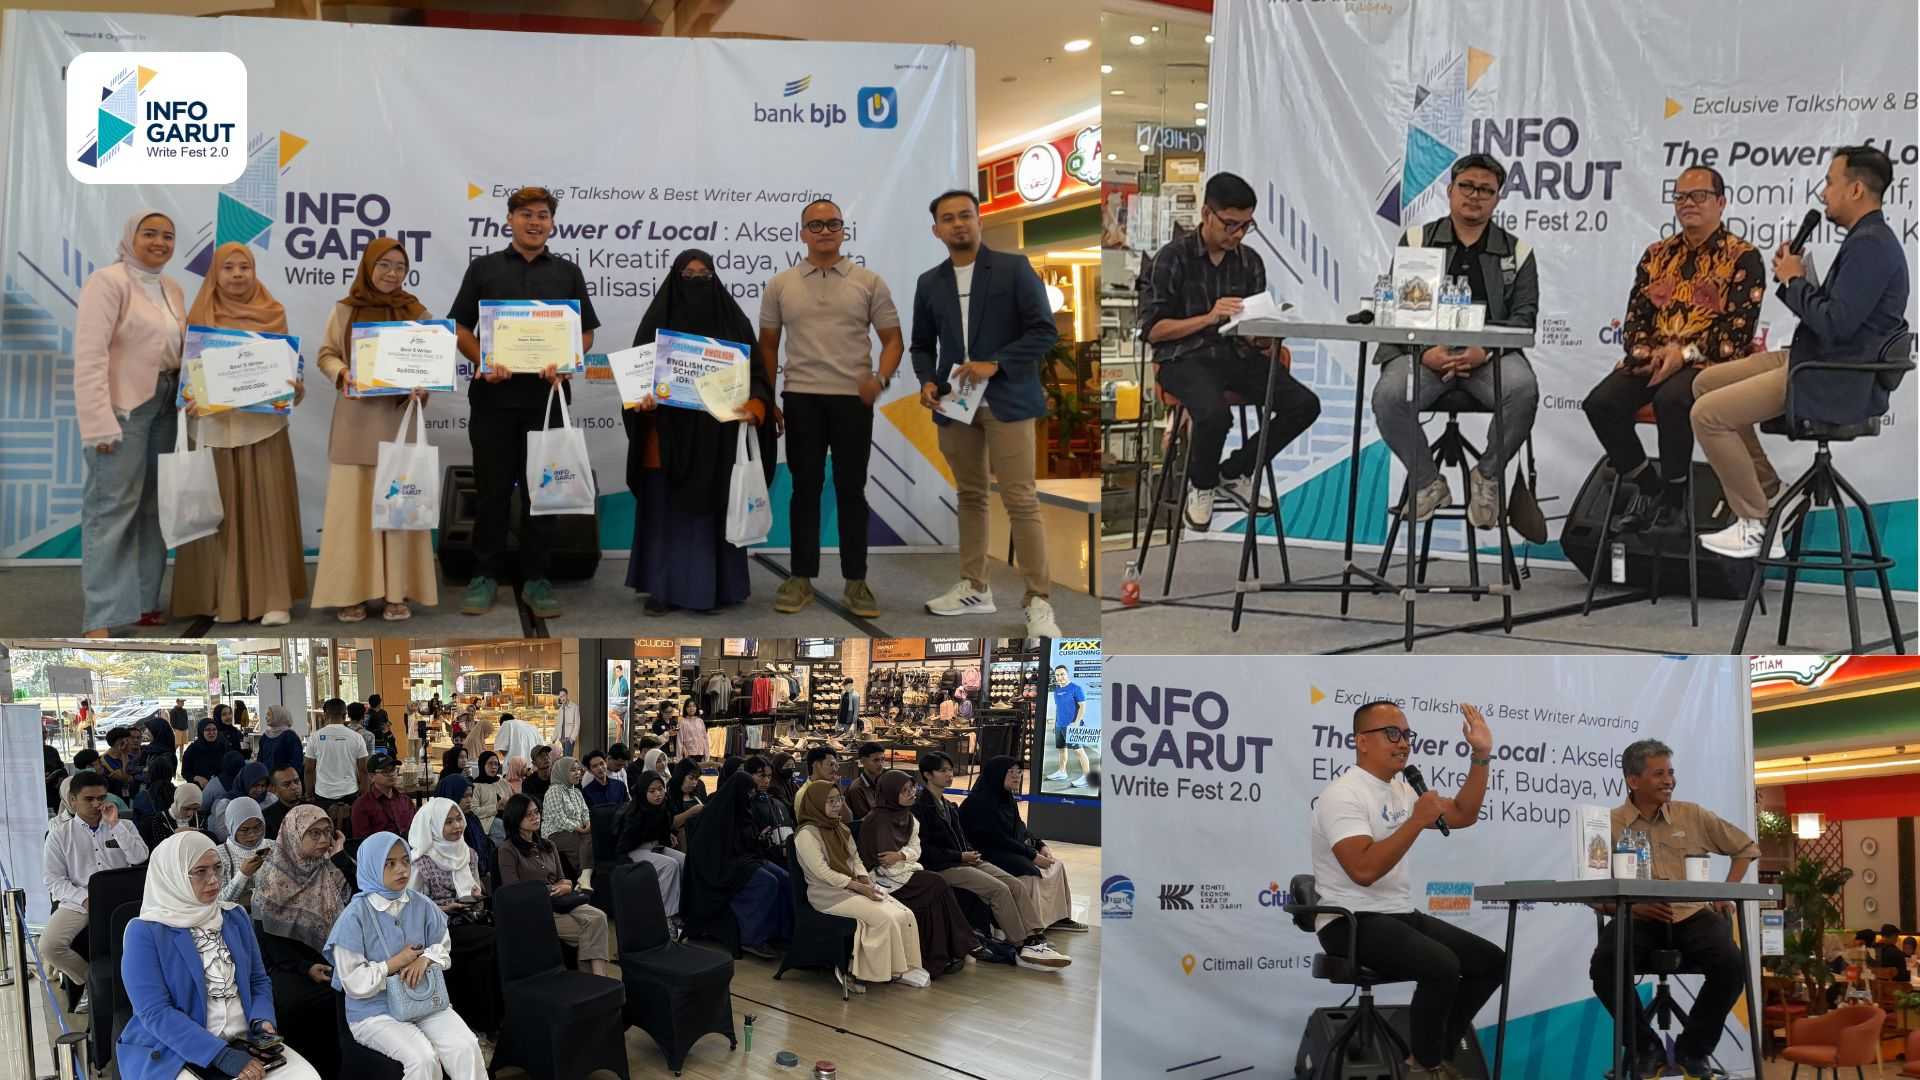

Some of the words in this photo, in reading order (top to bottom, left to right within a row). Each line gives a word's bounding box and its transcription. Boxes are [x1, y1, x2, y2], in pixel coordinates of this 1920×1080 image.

[754, 102, 804, 123] bank
[810, 103, 847, 128] bjb
[1693, 96, 1779, 114] Exclusive
[1786, 95, 1878, 113] Talkshow
[1883, 92, 1897, 110] &
[1471, 117, 1579, 157] INFO
[1663, 141, 1719, 167] The
[1729, 141, 1829, 167] Power
[1500, 160, 1622, 200] ARUT
[570, 185, 645, 200] Talkshow
[649, 187, 659, 200] &
[664, 187, 698, 201] Best
[704, 188, 751, 202] Writer
[755, 190, 832, 203] Awarding
[285, 192, 390, 227] INFO
[1525, 210, 1569, 231] Fest
[1575, 210, 1608, 231] 2.0
[468, 218, 512, 238] The
[549, 223, 608, 240] ower
[615, 220, 643, 240] of
[648, 221, 718, 241] Local
[723, 228, 729, 241] :
[735, 221, 857, 242] Akselsi
[714, 250, 778, 275] daya,
[285, 267, 335, 285] Write
[402, 270, 420, 286] .0
[666, 357, 703, 370] ENGLISH
[425, 418, 449, 429] arut
[583, 417, 614, 429] 15.00
[934, 642, 951, 653] YOUR
[952, 641, 969, 652] LOOK
[1061, 642, 1099, 650] MAX
[1750, 659, 1783, 671] PITIAM
[1111, 683, 1229, 730] INFO
[1486, 704, 1494, 717] &
[1498, 705, 1529, 721] Best
[1534, 708, 1575, 724] Writer
[1577, 712, 1639, 733] Awarding
[1069, 727, 1101, 736] MAXIMUM
[1069, 735, 1100, 743] COMFORT
[1111, 726, 1272, 773] GARUT
[1312, 725, 1356, 749] The
[1561, 745, 1624, 768] Aksele
[1111, 774, 1169, 797] Write
[1177, 778, 1223, 800] Fest
[1230, 781, 1261, 802] 2.0
[1516, 771, 1597, 800] Budaya,
[1502, 801, 1570, 828] Kabup
[1203, 957, 1252, 972] Citimall
[1257, 956, 1293, 969] Garut
